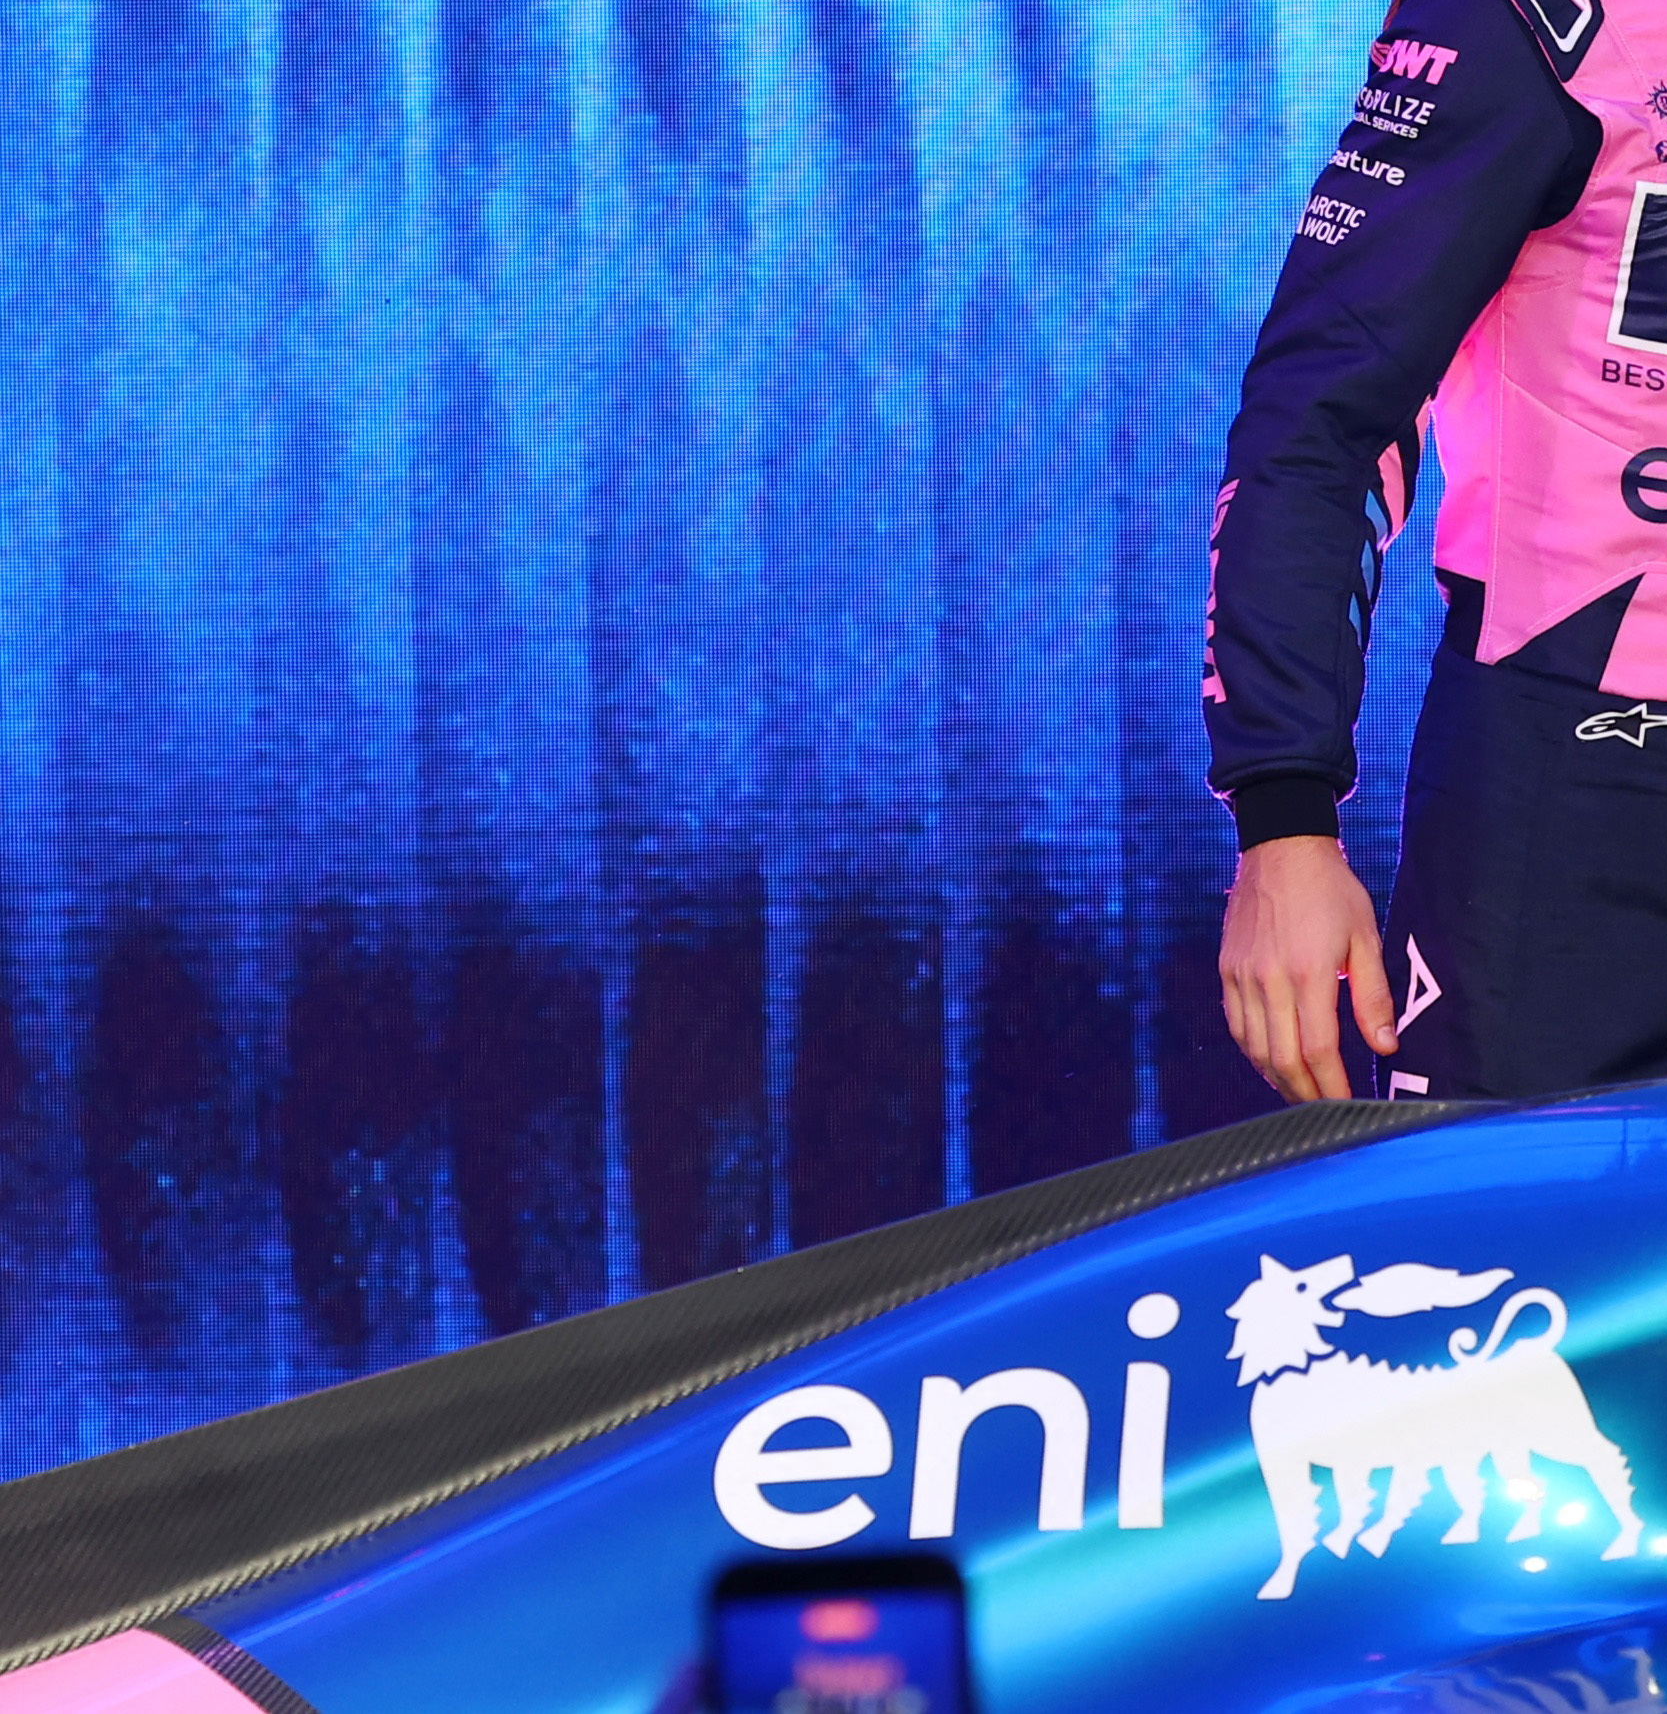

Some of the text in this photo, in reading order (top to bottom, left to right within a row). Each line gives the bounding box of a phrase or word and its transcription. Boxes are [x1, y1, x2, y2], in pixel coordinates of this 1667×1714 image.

[1307, 194, 1366, 228] ARCTIC
[1303, 216, 1350, 245] WOLF
[713, 1292, 1181, 1550] eni
